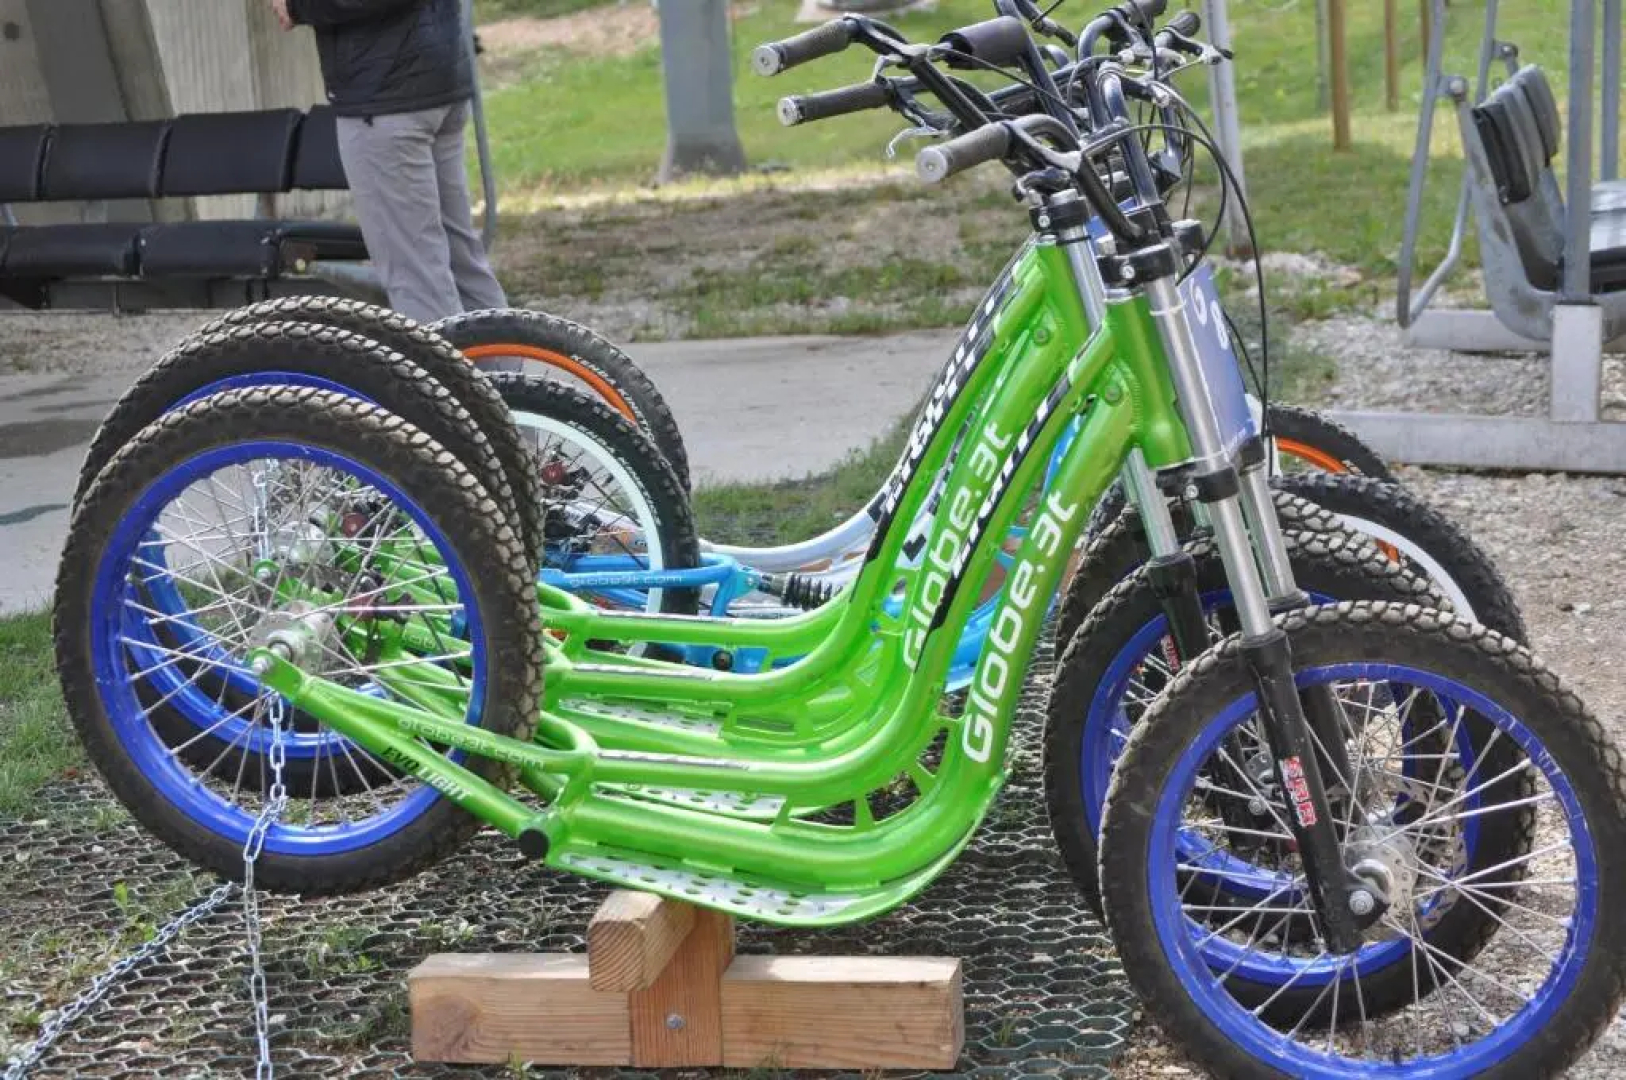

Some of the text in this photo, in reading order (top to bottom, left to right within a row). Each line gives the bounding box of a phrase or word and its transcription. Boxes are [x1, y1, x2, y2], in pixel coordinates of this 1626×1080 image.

[962, 489, 1077, 764] Globe.3t
[383, 746, 471, 800] EVO LIGHT
